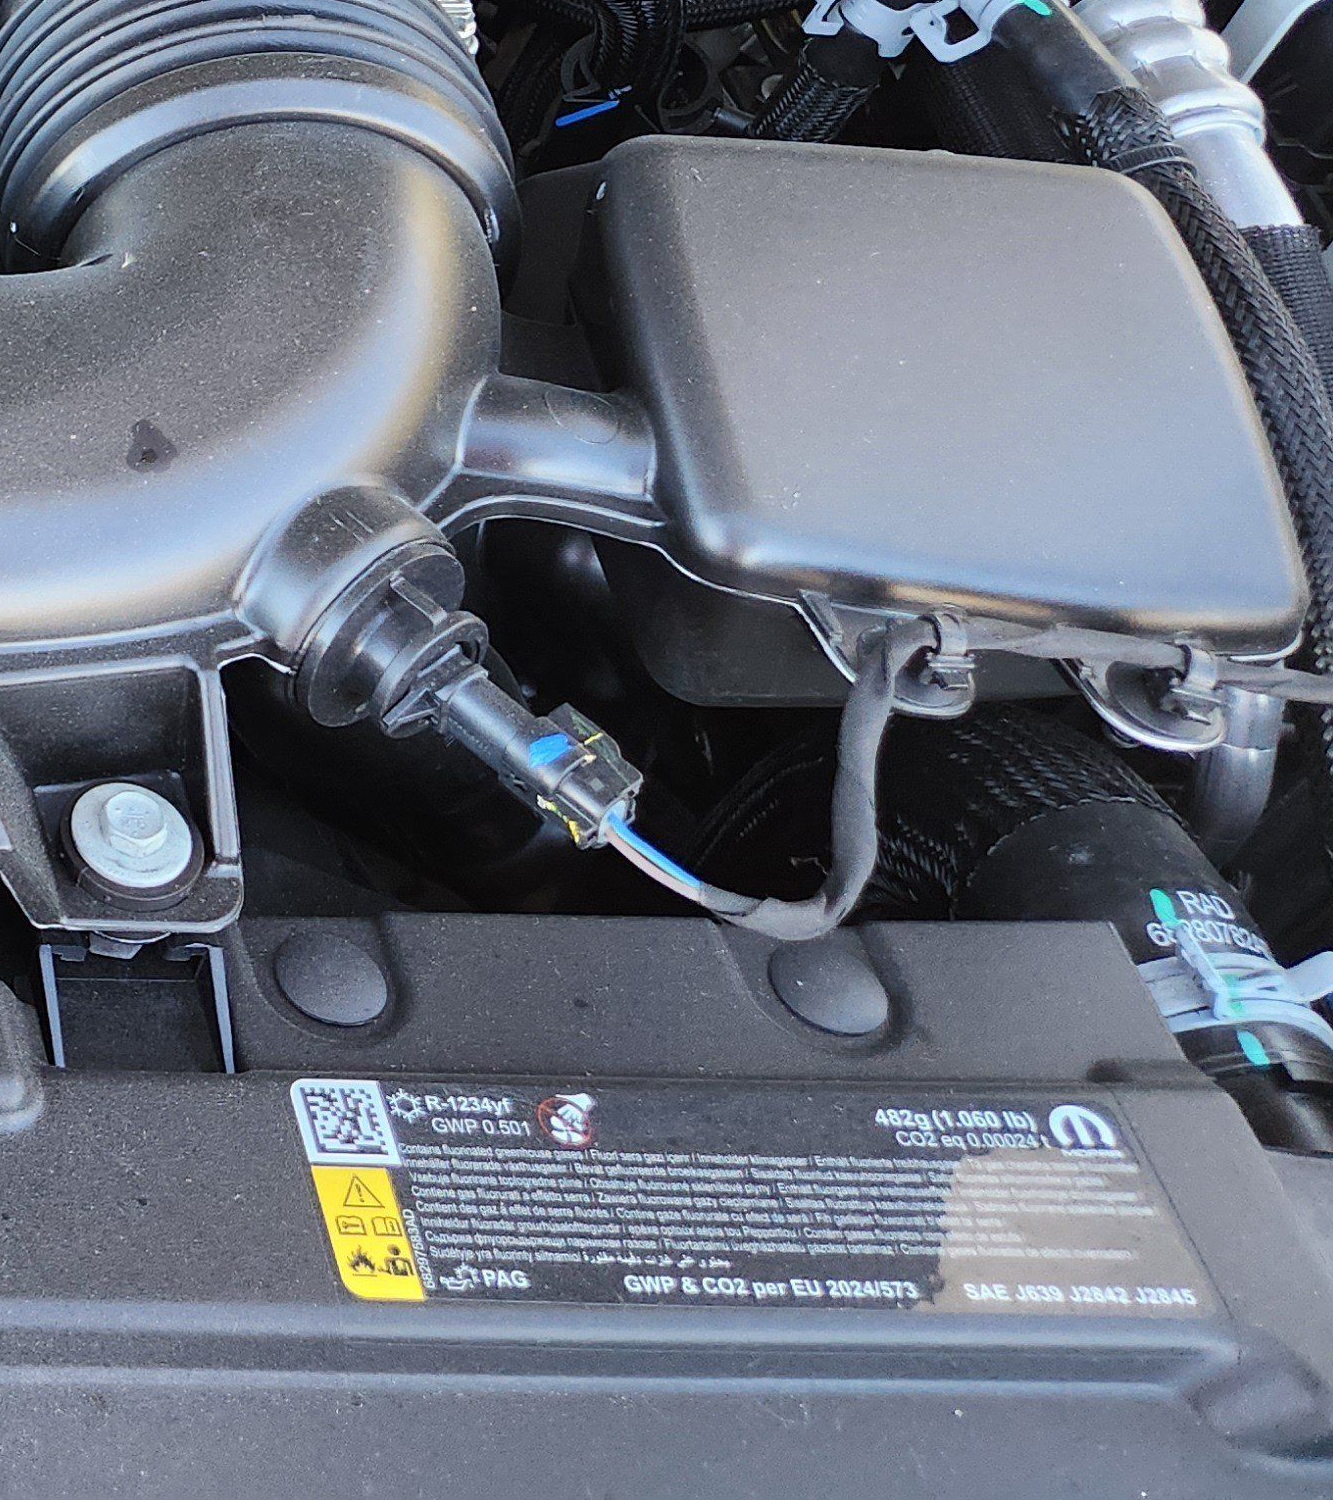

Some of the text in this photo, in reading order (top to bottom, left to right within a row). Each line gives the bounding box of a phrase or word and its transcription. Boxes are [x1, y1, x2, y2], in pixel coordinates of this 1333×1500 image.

[1176, 890, 1236, 920] RAD
[424, 1095, 515, 1116] R-1234yf
[431, 1117, 531, 1136] GWP 0.501
[874, 1108, 1039, 1133] 482g (1.060 lb)
[895, 1131, 938, 1147] CO2
[941, 1134, 967, 1150] eq
[966, 1133, 1039, 1149] 0.00024
[482, 1269, 532, 1289] PAG
[623, 1275, 920, 1300] GWP & CO2 per EU 2024/573
[963, 1283, 1198, 1307] SAE J639 J2842 J2845
